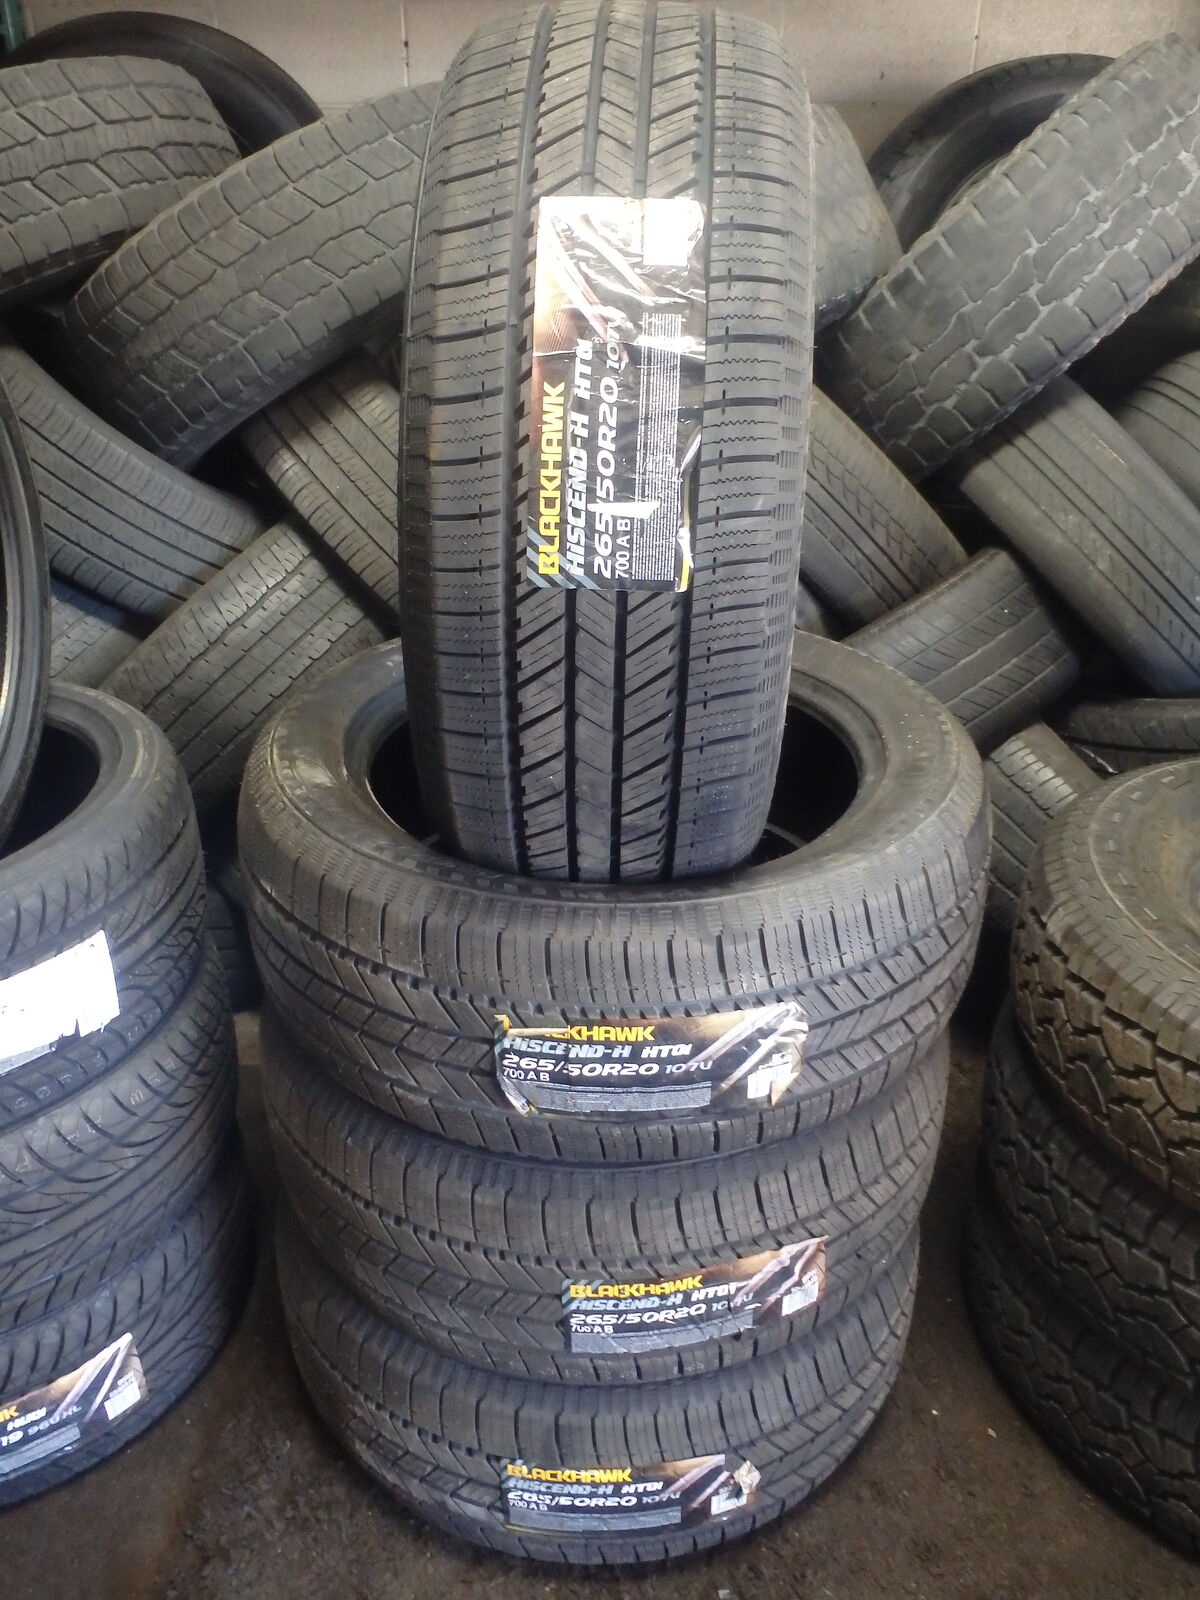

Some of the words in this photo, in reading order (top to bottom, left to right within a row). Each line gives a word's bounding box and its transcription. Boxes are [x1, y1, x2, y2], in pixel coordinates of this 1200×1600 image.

[538, 381, 565, 575] BLACKHAWK
[616, 519, 631, 531] B
[616, 535, 631, 548] A
[615, 551, 630, 579] 700
[502, 1053, 660, 1076] 265/50R20
[503, 1067, 525, 1080] 700
[527, 1071, 538, 1080] A
[540, 1073, 550, 1082] B
[570, 1275, 703, 1298] BLACKHAWK
[570, 1303, 707, 1325] 265/50R20
[507, 1464, 632, 1483] BLACKHAWK
